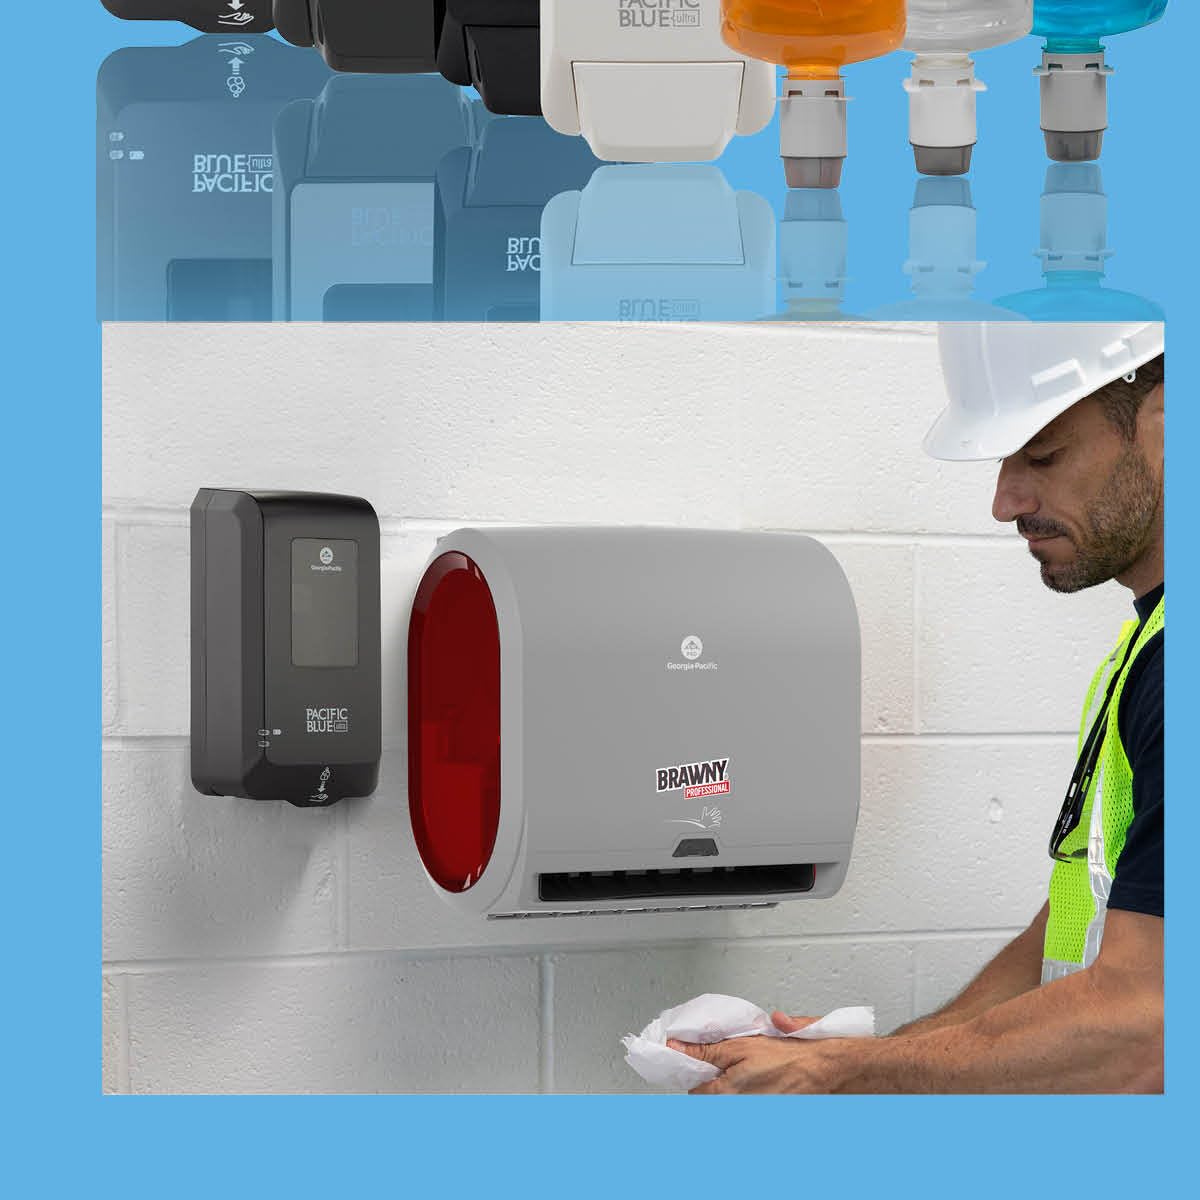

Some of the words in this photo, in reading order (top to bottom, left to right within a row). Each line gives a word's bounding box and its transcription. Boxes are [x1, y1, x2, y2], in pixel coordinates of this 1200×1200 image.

[618, 9, 671, 28] BLUE
[676, 12, 696, 24] ultra
[306, 708, 348, 720] PACIFIC
[306, 720, 333, 732] BLUE
[657, 759, 728, 791] BRAWNY
[686, 782, 729, 798] PROFESSIONAL
